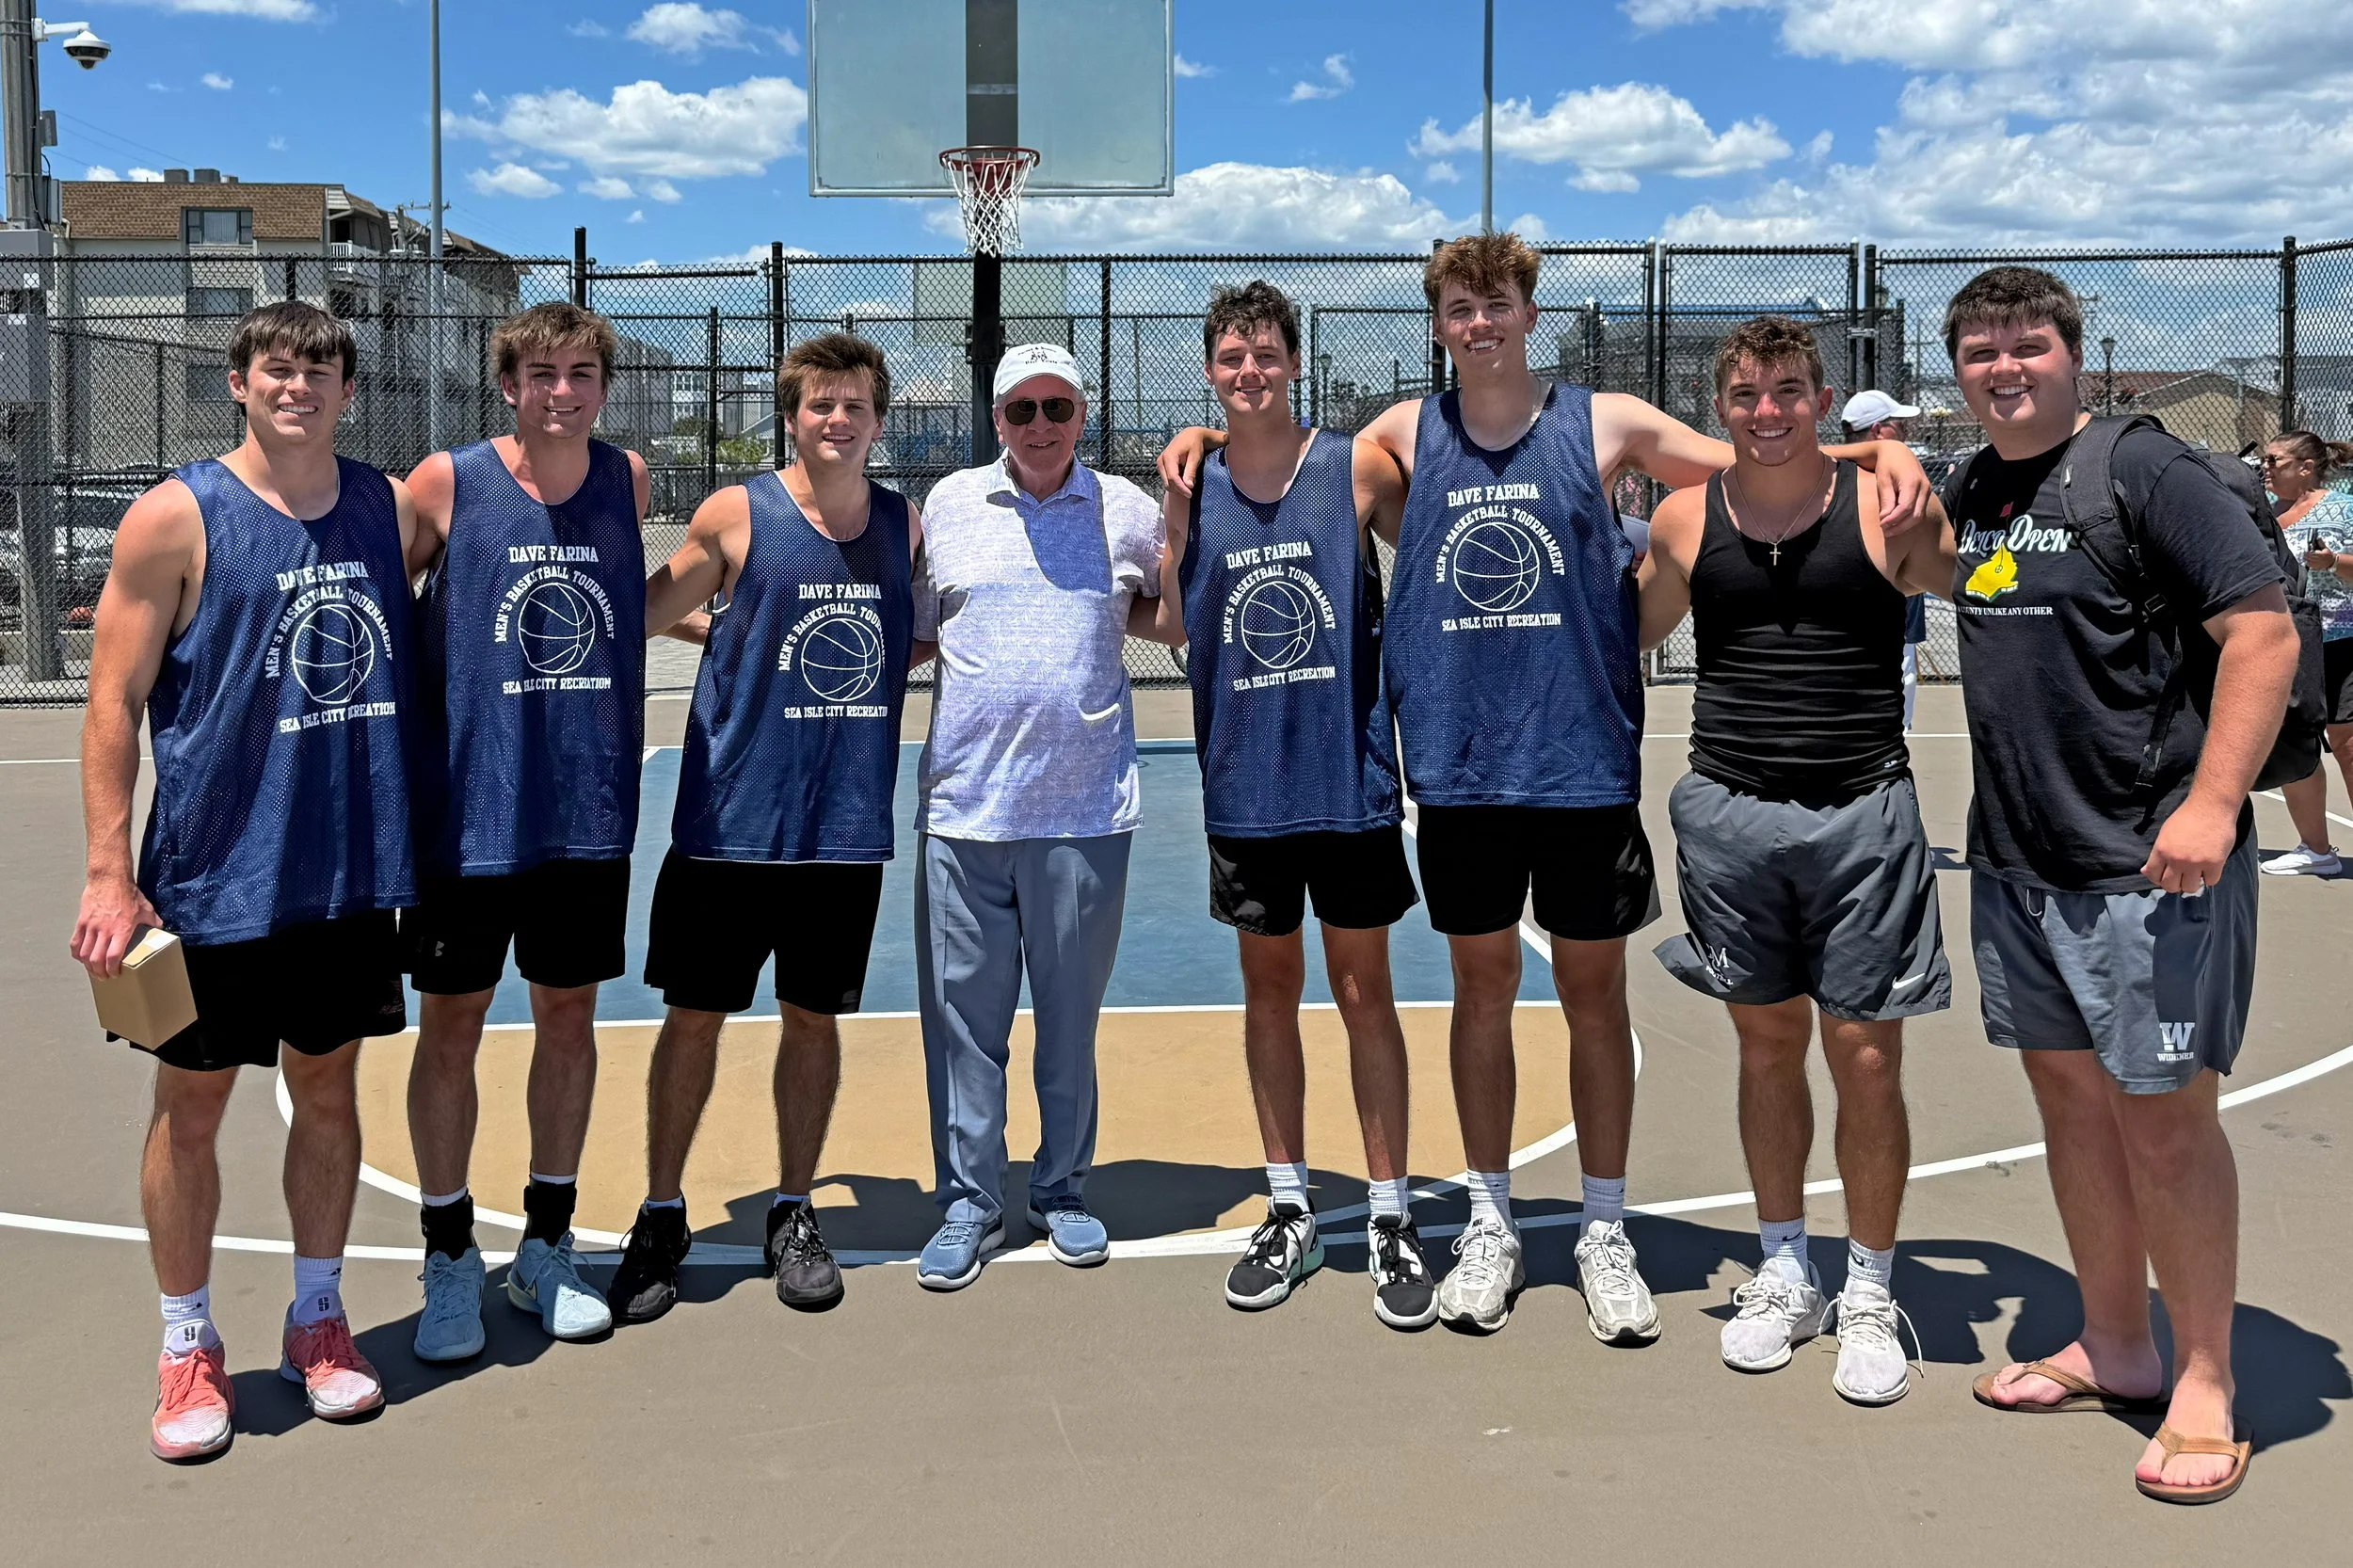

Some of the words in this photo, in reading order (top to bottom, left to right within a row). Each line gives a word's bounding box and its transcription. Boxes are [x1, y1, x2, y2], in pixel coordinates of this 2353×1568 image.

[1447, 487, 1482, 507] DAVE
[1485, 483, 1541, 502] FARINA
[507, 546, 546, 563] DAVE
[549, 546, 600, 563] FARINA
[1225, 548, 1261, 569] DAVE
[1262, 541, 1313, 562] FARINA
[1435, 544, 1450, 584] MEN'S
[1446, 504, 1508, 545] BASKETBALL
[1512, 507, 1565, 576] TOURNAMENT
[798, 584, 833, 600] DAVE
[836, 584, 882, 600] FARINA
[1228, 564, 1285, 606] BASKETBALL
[1288, 566, 1337, 630] TOURNAMENT
[494, 601, 513, 643] MEN'S
[505, 566, 568, 603] BASKETBALL
[572, 570, 615, 640] TOURNAMENT
[1983, 607, 2008, 616] UNLIKE
[2008, 606, 2023, 616] ANY
[2023, 606, 2054, 616] OTHER
[1223, 605, 1235, 644] MEN'S
[1442, 618, 1458, 632] SEA
[1459, 616, 1481, 630] ISLE
[1482, 616, 1505, 628] CITY
[1506, 613, 1561, 627] RECREATION
[778, 633, 798, 672] MEN'S
[792, 602, 856, 637] BASKETBALL
[265, 634, 283, 679] MEN'S
[502, 680, 522, 695] SEA
[536, 678, 557, 691] CITY
[1233, 679, 1252, 692] SEA
[1253, 675, 1269, 688] ISLE
[1288, 665, 1336, 682] RECREATION
[280, 717, 301, 733] SEA
[321, 708, 346, 725] CITY
[784, 707, 802, 719] SEA
[804, 706, 824, 718] ISLE
[824, 705, 844, 717] CITY
[846, 706, 888, 718] RECREATI
[2159, 1022, 2196, 1052] W
